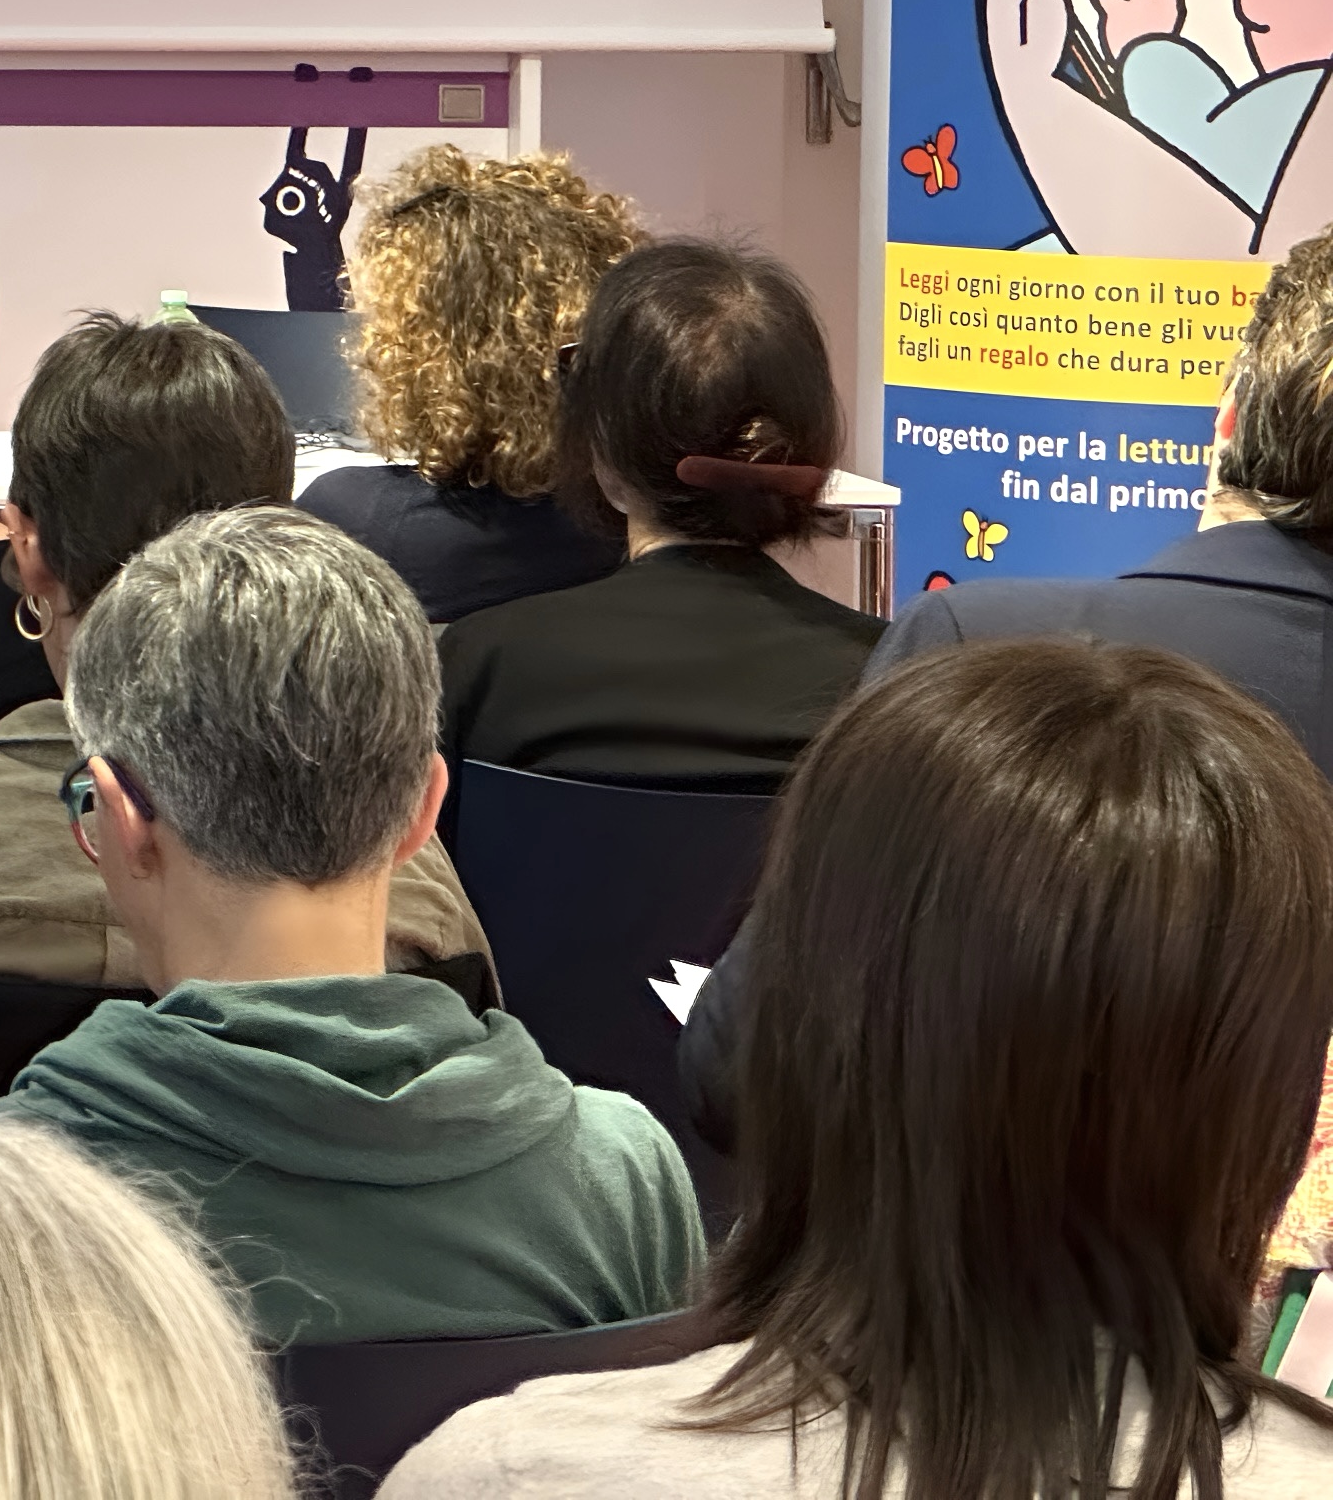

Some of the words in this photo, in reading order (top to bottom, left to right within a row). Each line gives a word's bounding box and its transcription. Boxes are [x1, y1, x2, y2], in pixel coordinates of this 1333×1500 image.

[899, 266, 950, 296] Leggi
[955, 274, 1002, 299] ogni
[1008, 276, 1085, 302] giorno
[1094, 283, 1139, 304] con
[1149, 281, 1165, 304] il
[1174, 285, 1221, 307] tuo
[1231, 284, 1262, 308] ba
[898, 301, 943, 328] Digli
[949, 304, 989, 329] così
[995, 312, 1079, 341] quanto
[1087, 313, 1152, 339] bene
[1161, 316, 1193, 344] gli
[1202, 323, 1247, 343] vuo
[897, 334, 940, 362] fagli
[947, 343, 972, 361] un
[979, 344, 1050, 370] regalo
[1057, 348, 1102, 372] che
[1109, 350, 1170, 375] dura
[1179, 357, 1226, 381] per
[895, 417, 1010, 455] Progetto
[1017, 431, 1069, 462] per
[1078, 431, 1107, 462] la
[1118, 433, 1215, 466] lettur
[1000, 469, 1040, 501] fin
[1049, 472, 1099, 505] dal
[1109, 479, 1208, 513] primo
